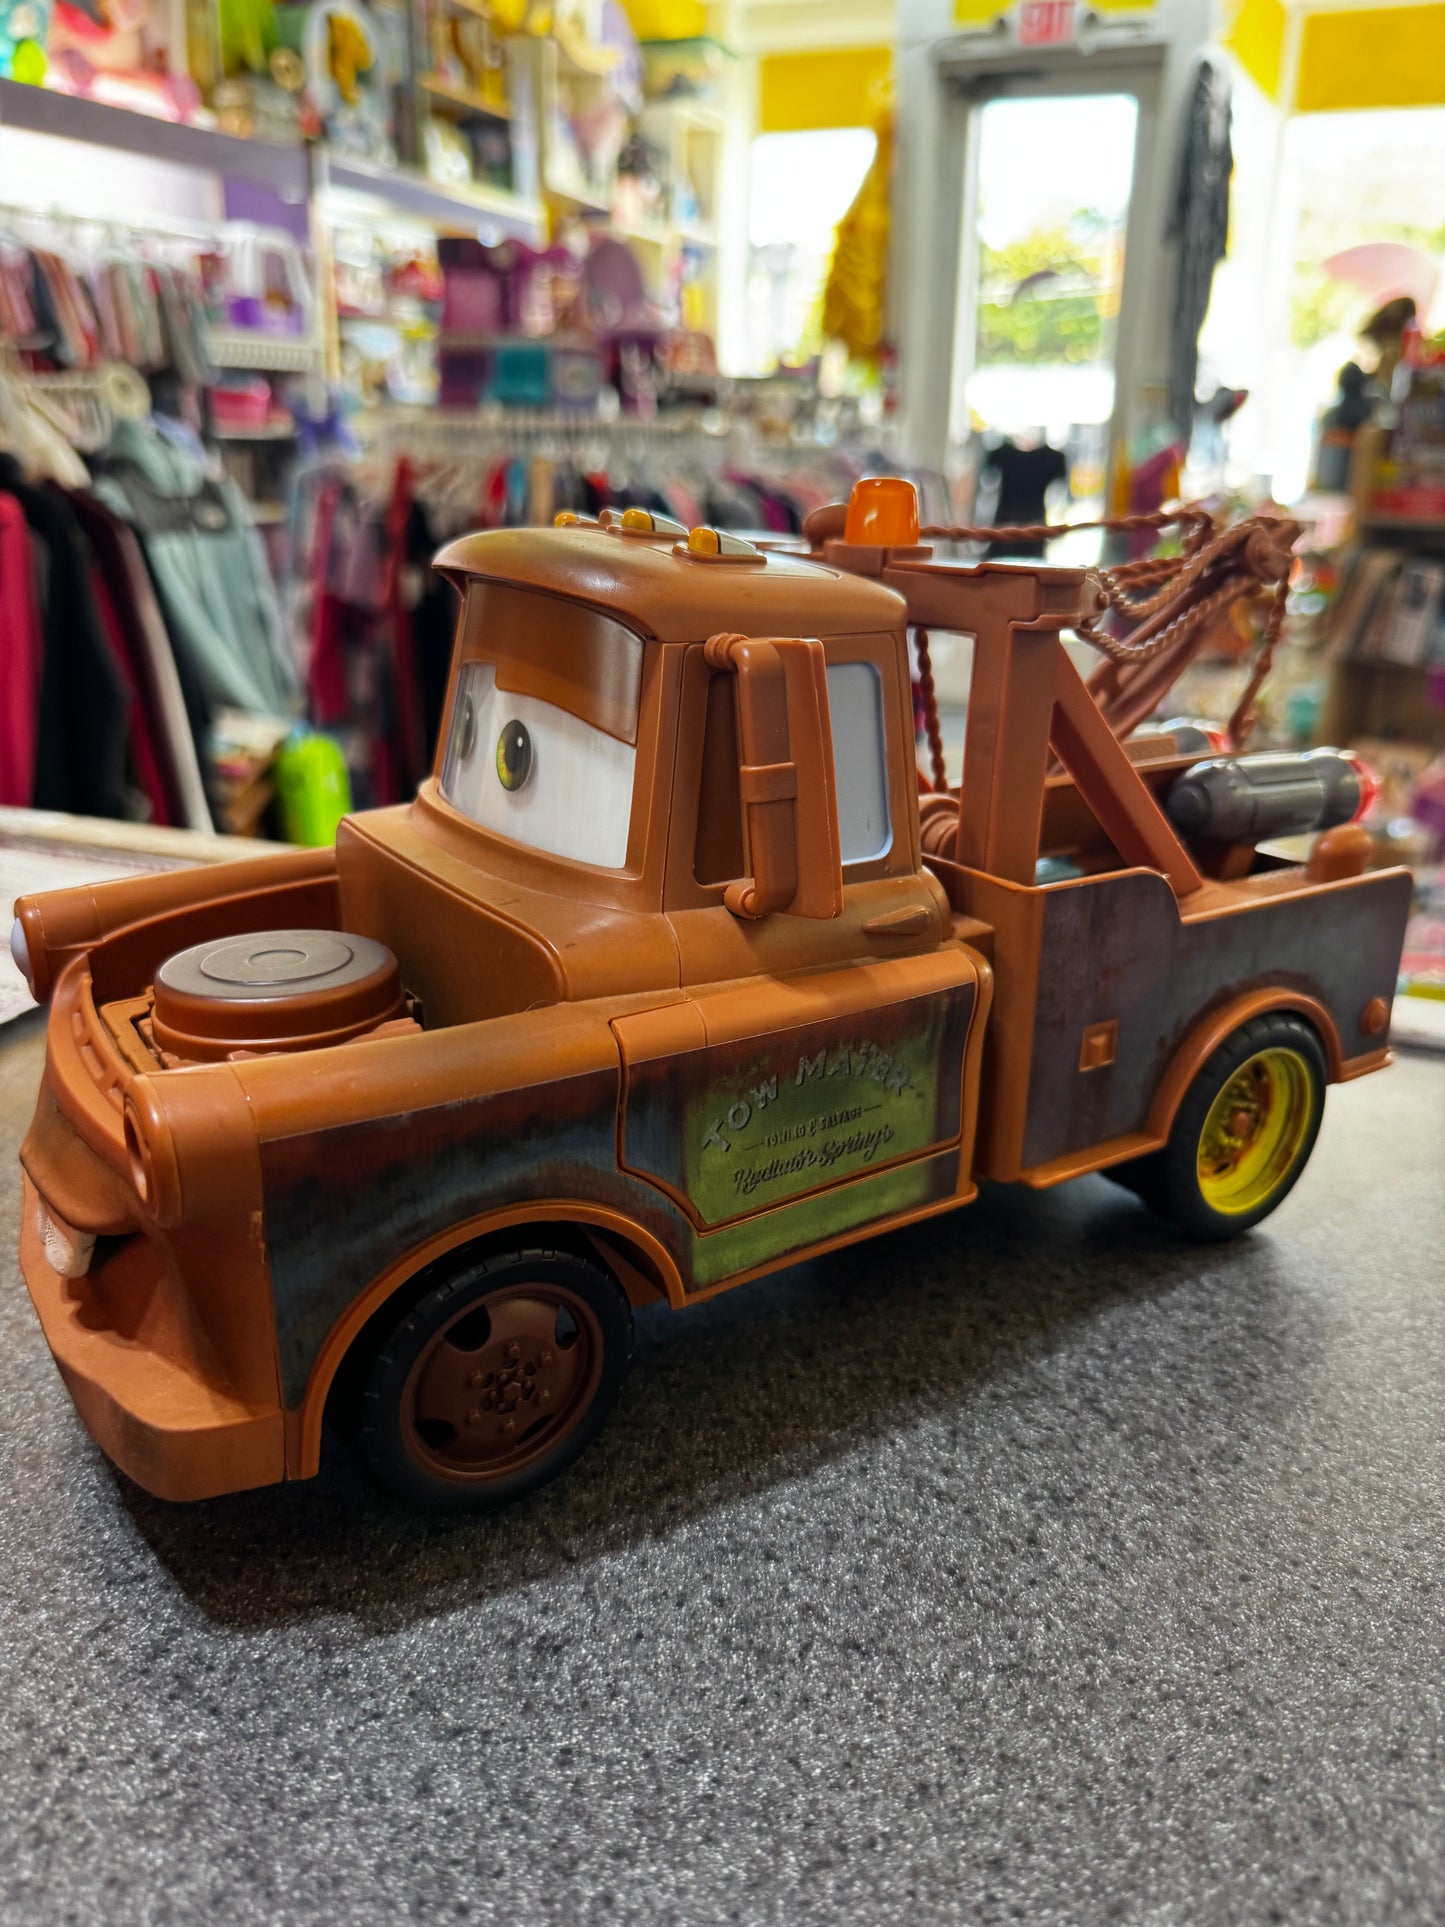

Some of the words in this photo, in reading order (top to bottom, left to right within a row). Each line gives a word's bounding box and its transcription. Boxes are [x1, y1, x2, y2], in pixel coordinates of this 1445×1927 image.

[702, 1073, 779, 1152] TOW
[796, 1042, 915, 1097] MATER
[765, 1124, 806, 1148] TOWING
[820, 1106, 863, 1130] SALVAGE
[819, 1124, 895, 1167] Springs
